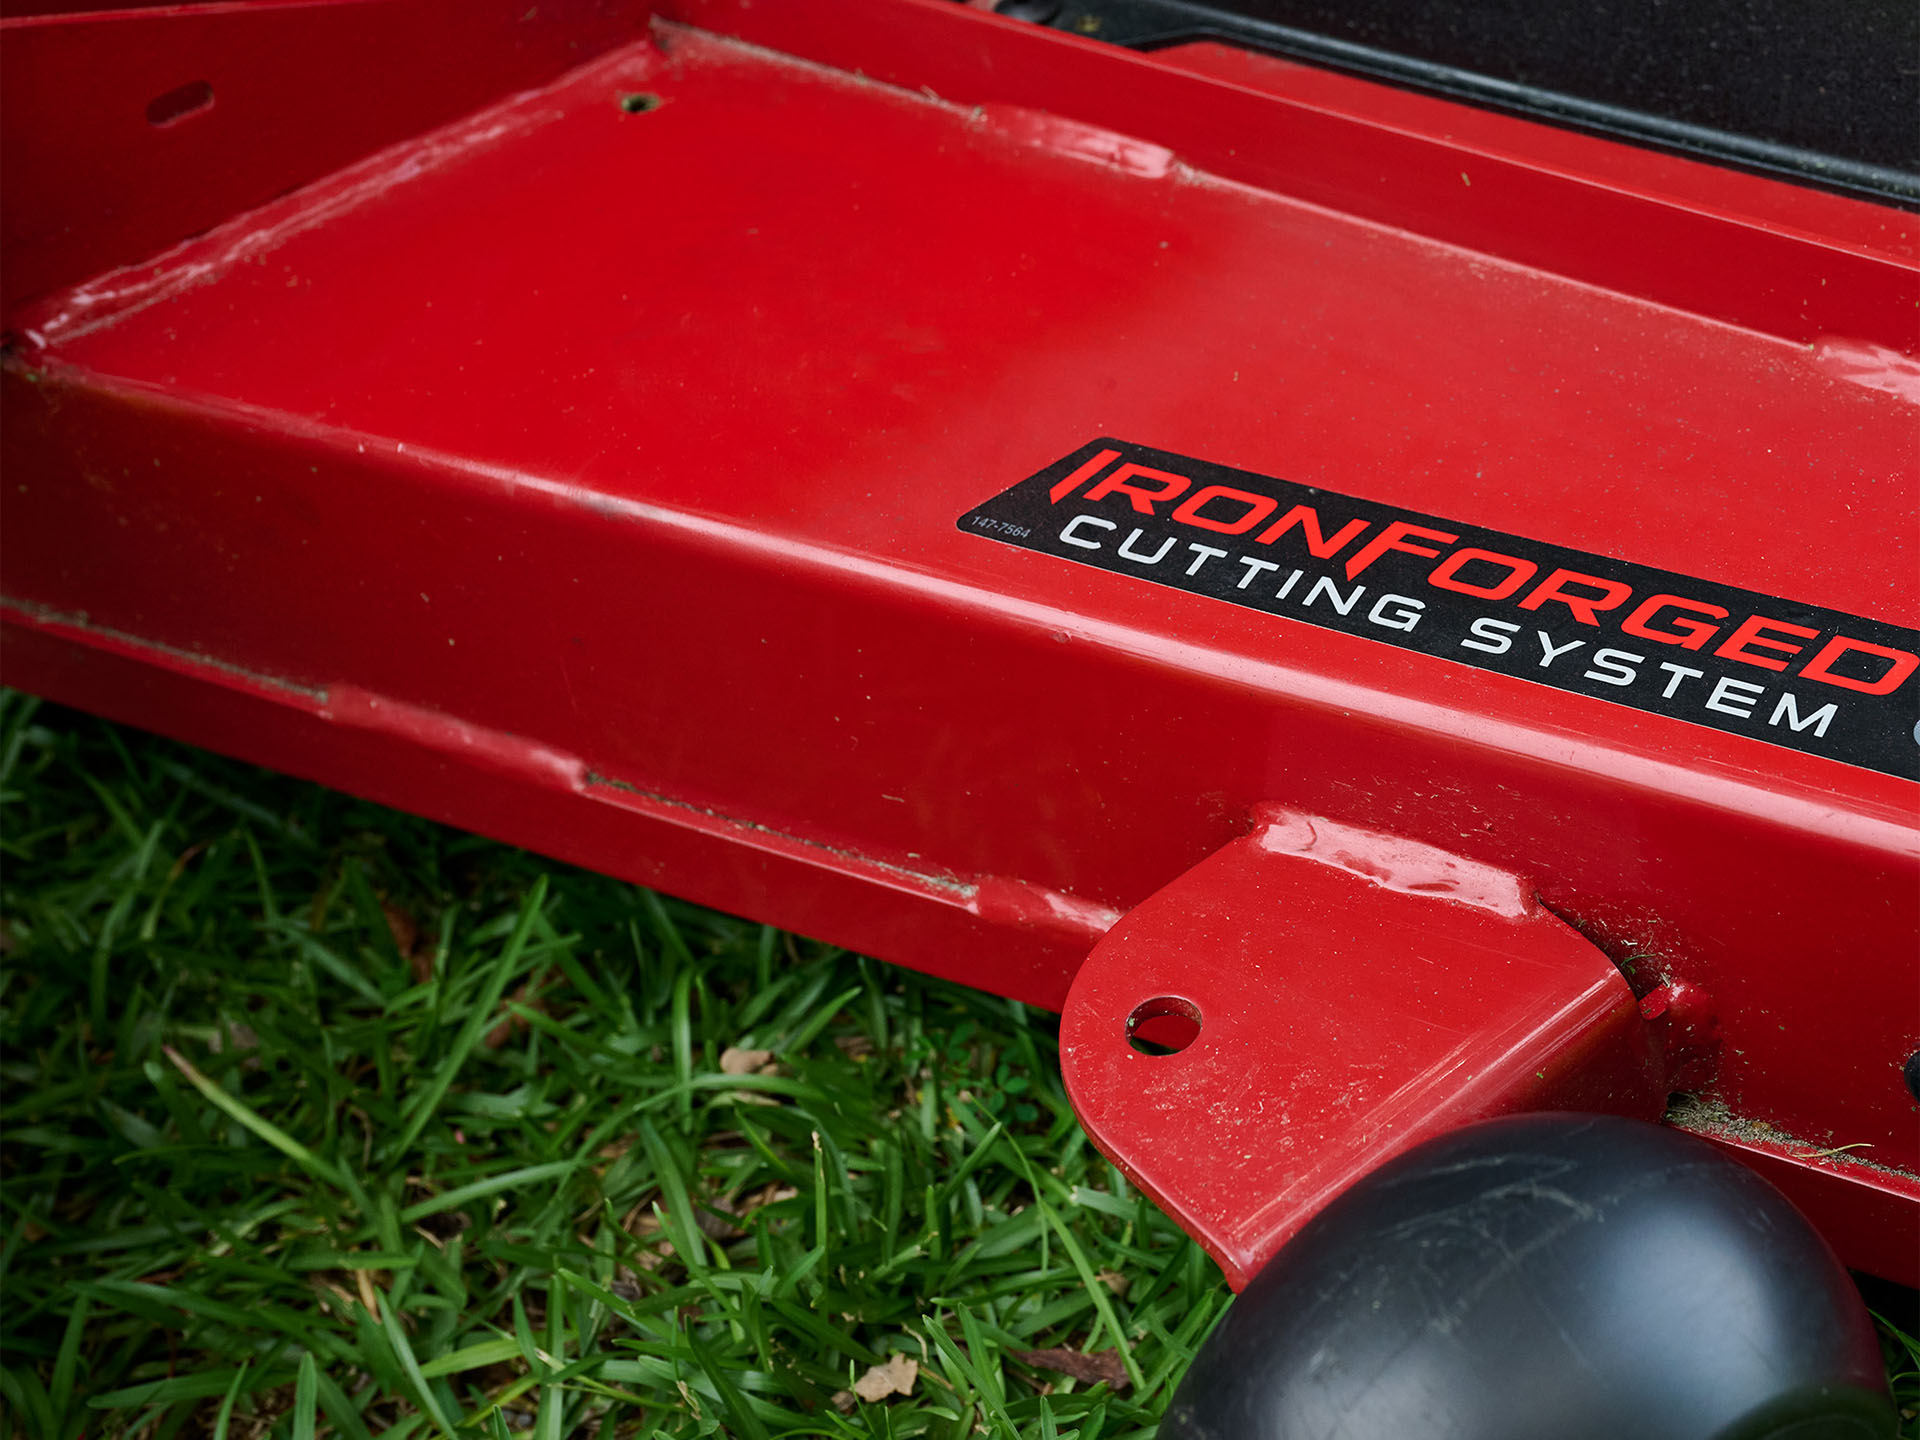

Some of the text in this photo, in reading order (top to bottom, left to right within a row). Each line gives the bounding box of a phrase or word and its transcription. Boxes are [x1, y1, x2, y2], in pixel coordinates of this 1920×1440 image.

[971, 515, 1031, 538] 147-7564
[1049, 449, 1920, 696] IRONFORGED
[1059, 514, 1839, 738] CUTTING SYSTEM
